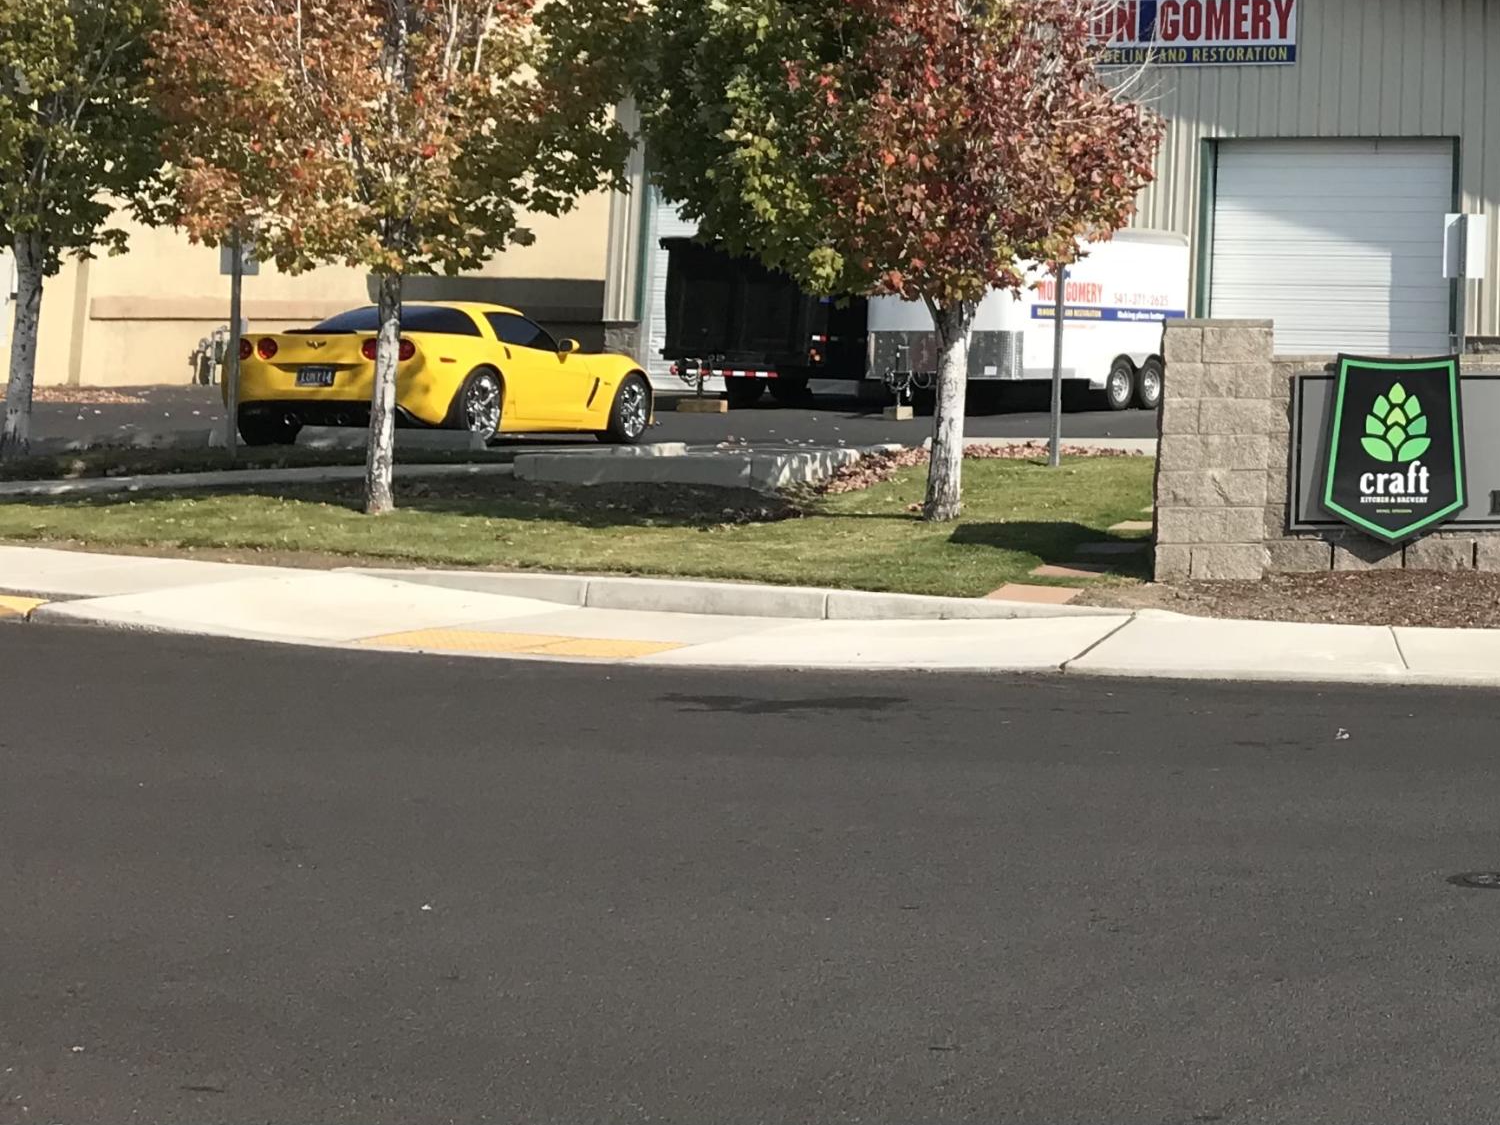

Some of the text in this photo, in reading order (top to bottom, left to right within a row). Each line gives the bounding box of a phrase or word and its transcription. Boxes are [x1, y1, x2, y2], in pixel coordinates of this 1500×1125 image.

[1160, 48, 1187, 62] AND
[1192, 46, 1288, 62] RESTORATION
[1037, 280, 1103, 303] MOGOMERY
[1360, 460, 1430, 494] craft
